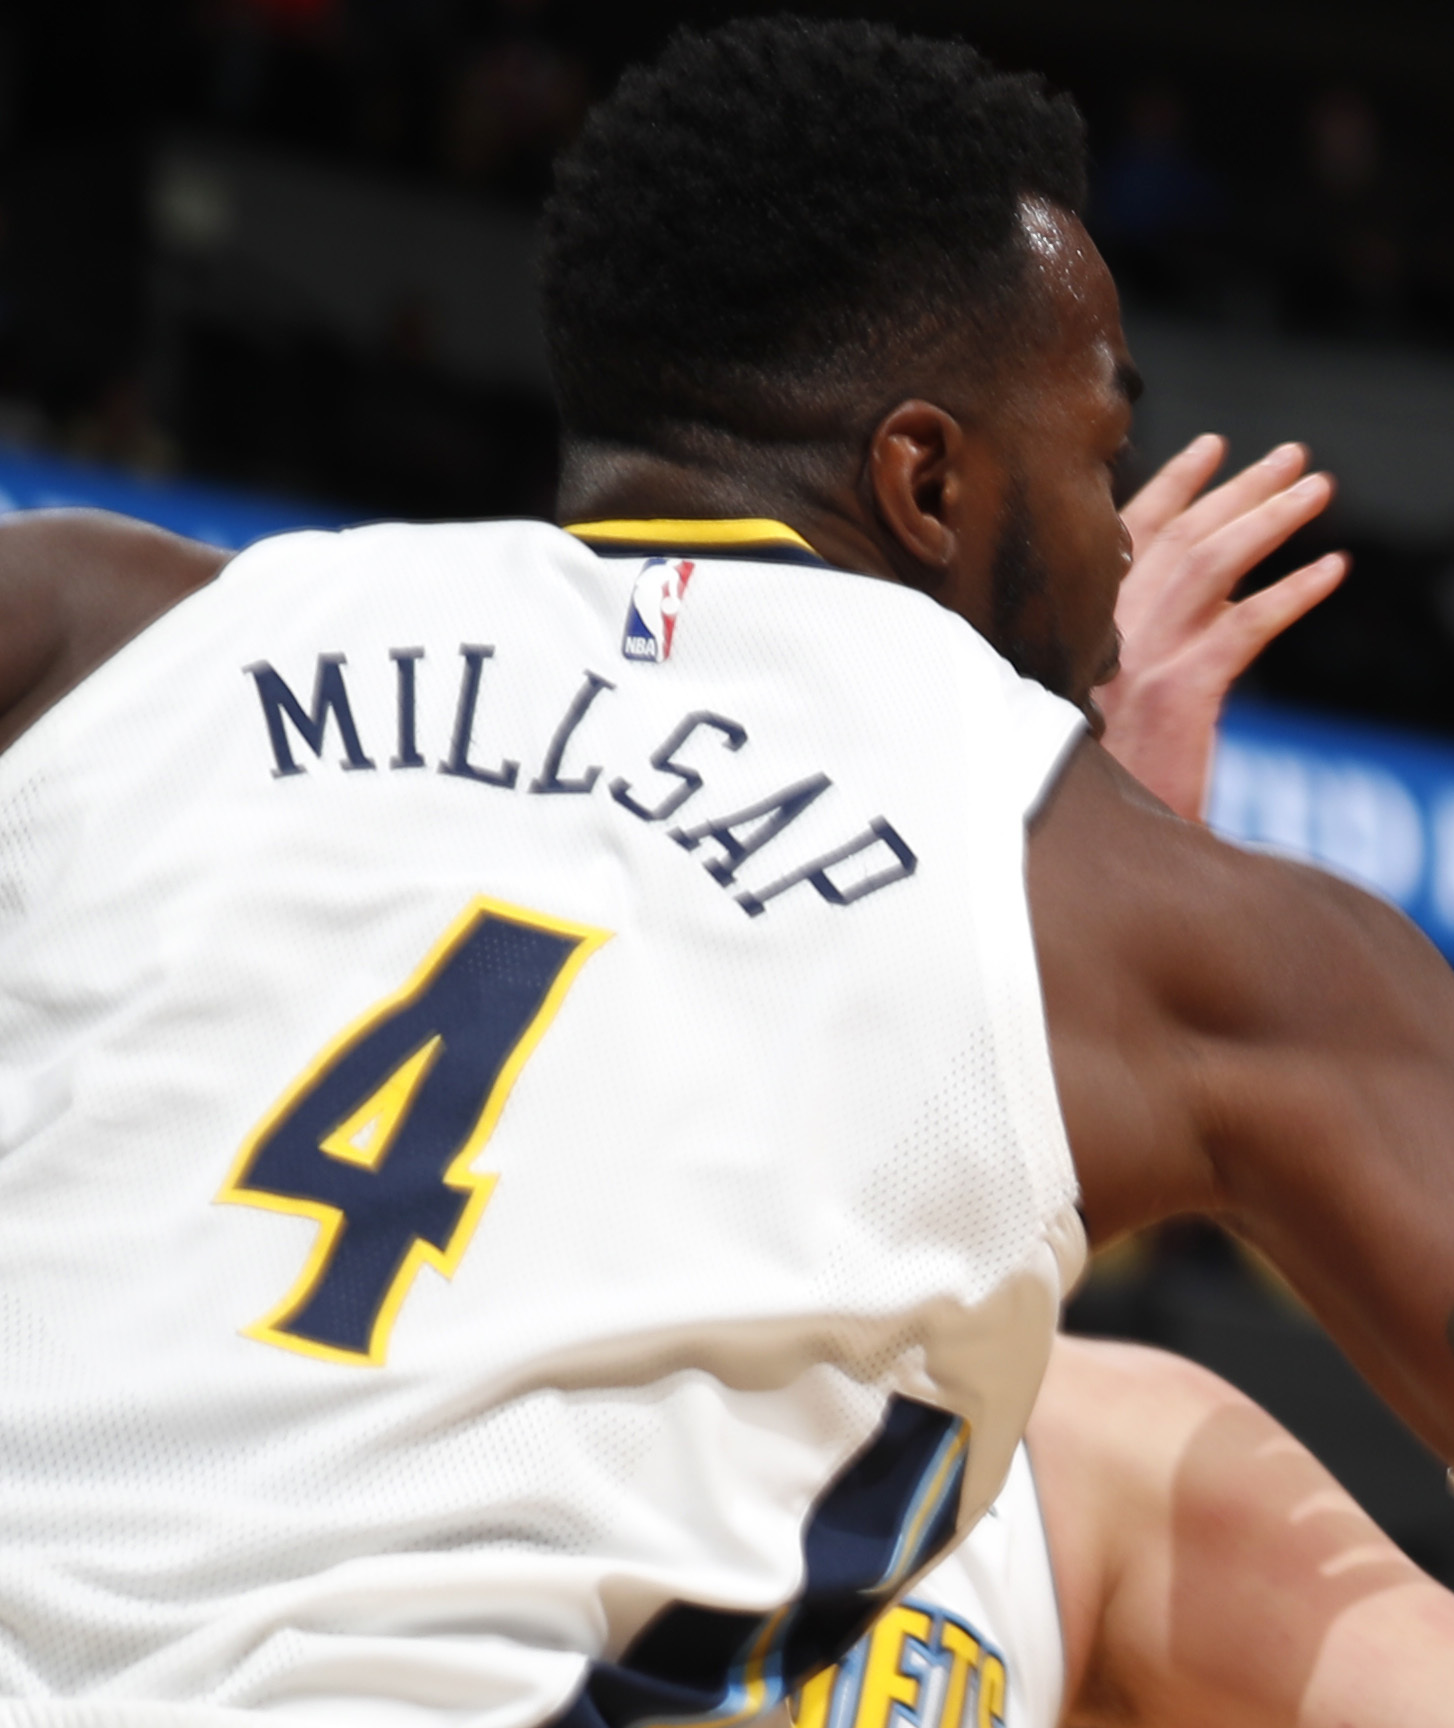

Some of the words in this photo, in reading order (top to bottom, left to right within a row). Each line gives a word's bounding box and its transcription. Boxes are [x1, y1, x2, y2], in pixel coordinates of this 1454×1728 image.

[243, 642, 919, 918] MILLSAP
[624, 635, 656, 657] NBA
[213, 894, 616, 1367] 4
